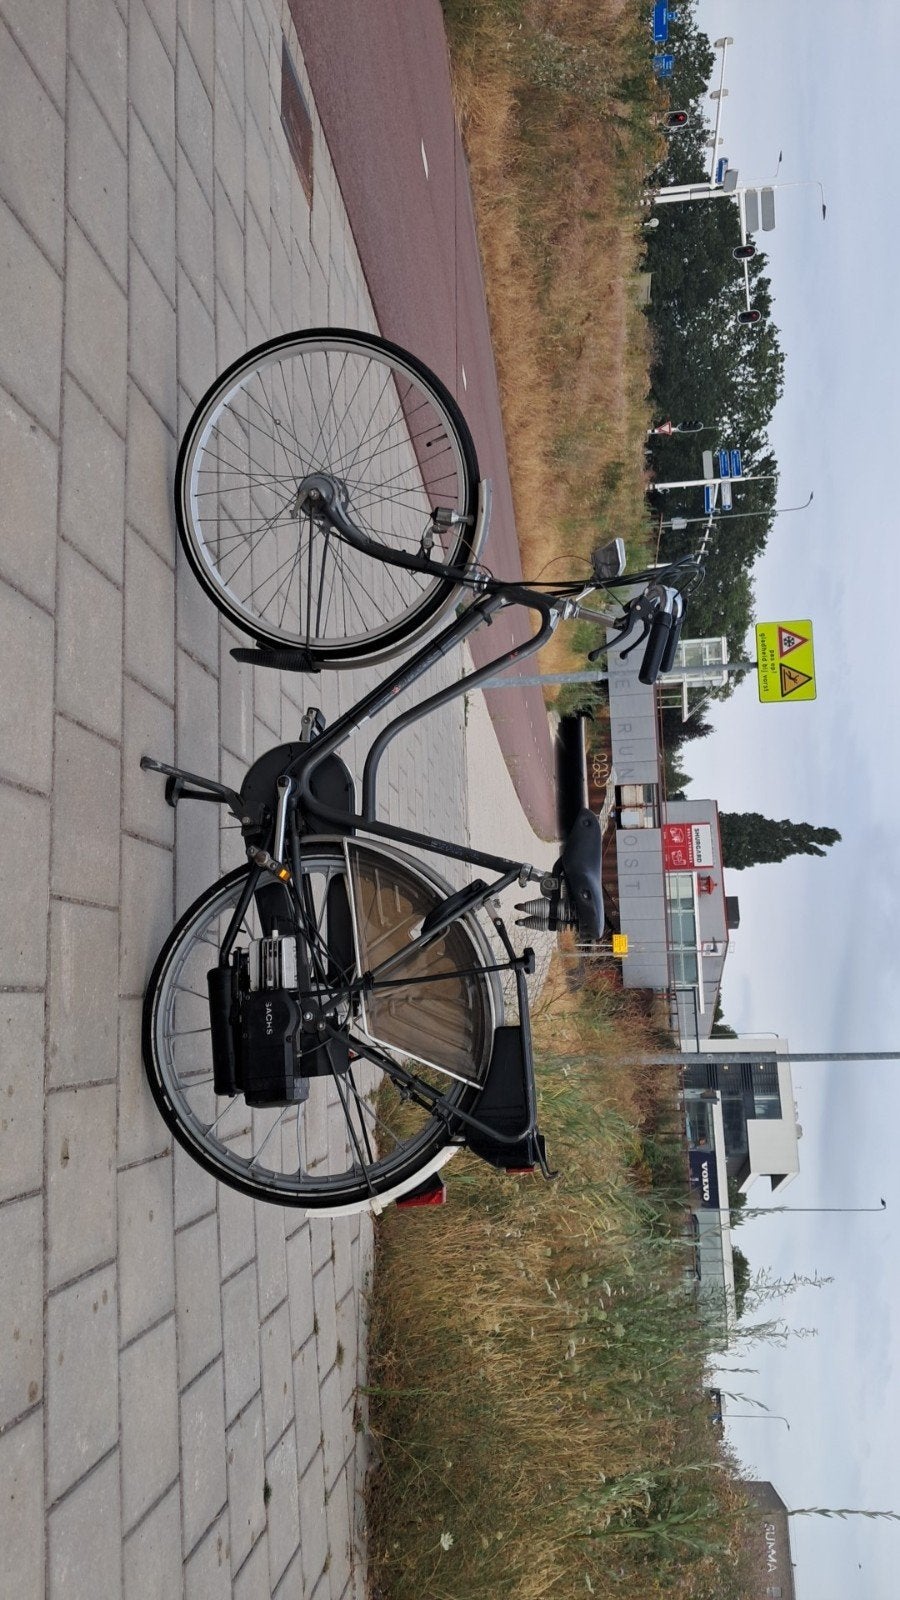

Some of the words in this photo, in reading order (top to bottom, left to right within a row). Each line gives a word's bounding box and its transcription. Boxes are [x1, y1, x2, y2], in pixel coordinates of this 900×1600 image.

[759, 633, 767, 662] gladheid
[618, 723, 634, 778] RUN
[694, 828, 702, 863] SHURGARD
[265, 1002, 273, 1035] SACHS
[702, 1161, 710, 1201] VOLVO
[765, 1524, 777, 1572] SUMMA
